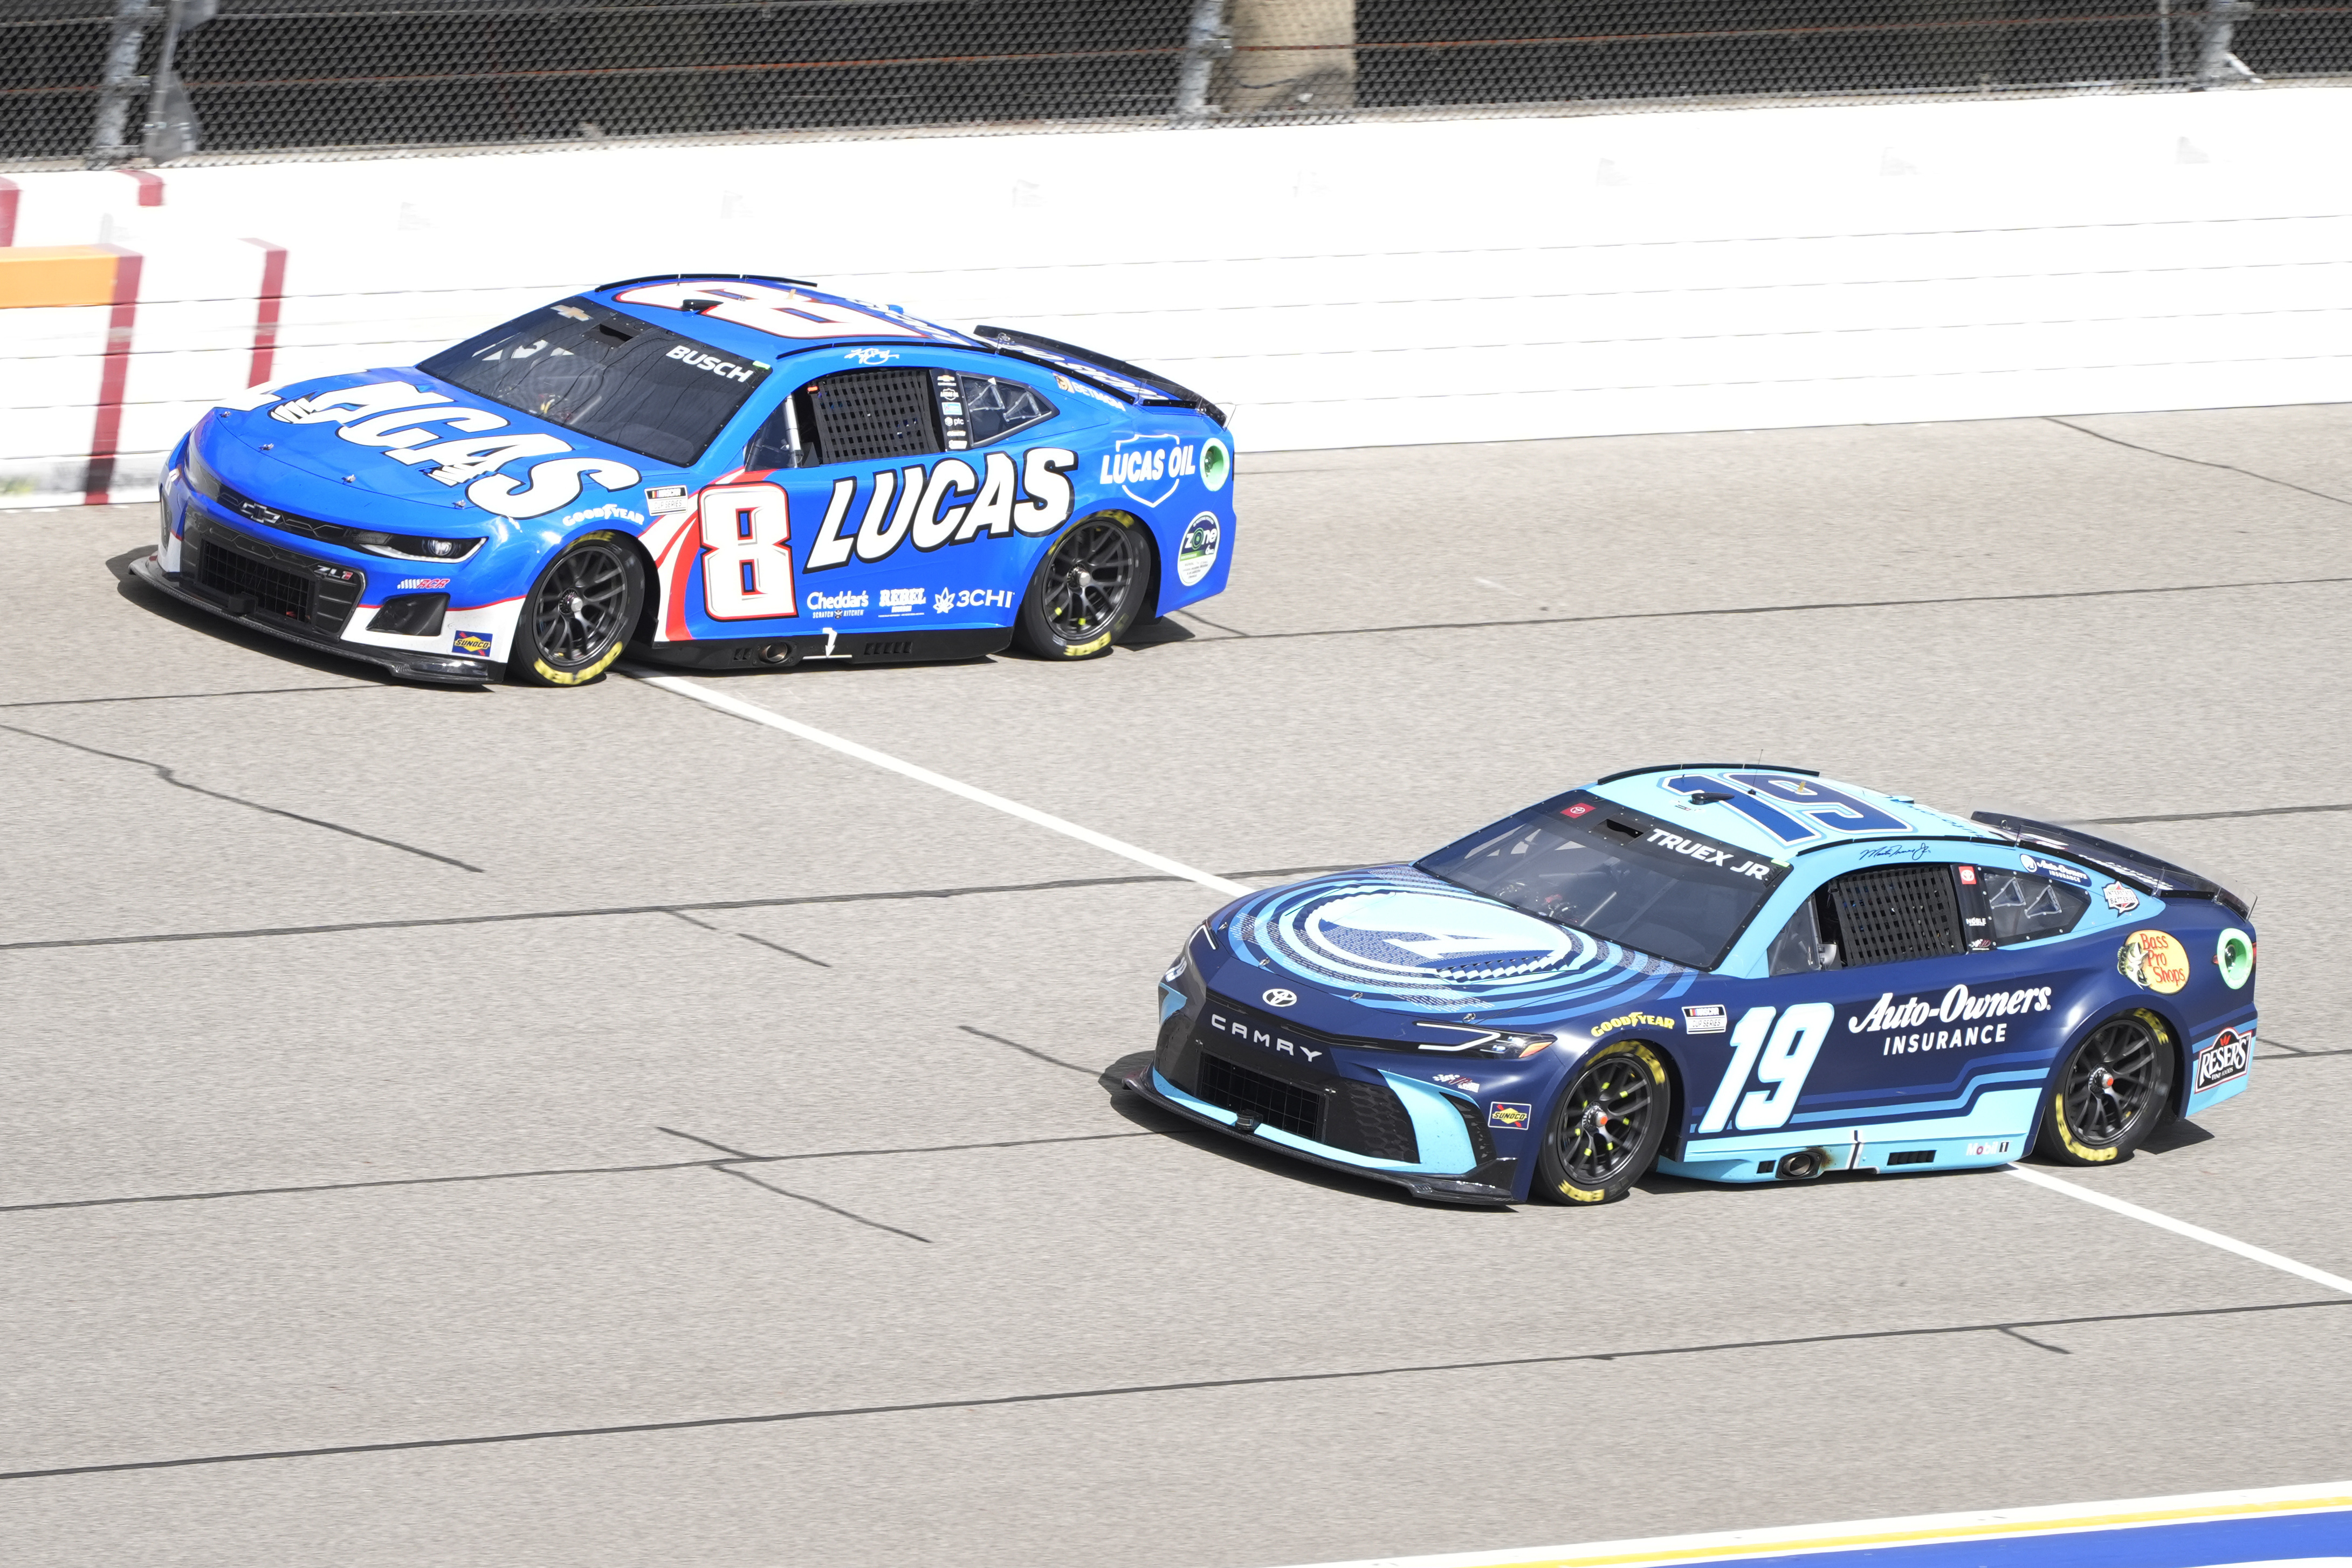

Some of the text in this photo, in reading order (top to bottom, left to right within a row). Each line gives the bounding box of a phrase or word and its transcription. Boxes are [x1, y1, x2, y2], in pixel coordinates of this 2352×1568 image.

[665, 345, 754, 382] BUSCH
[1100, 445, 1195, 484] LUCAS OIL
[658, 488, 681, 497] NASCAR
[654, 499, 682, 509] CUP SERIES
[803, 448, 1078, 574] LUCAS
[562, 504, 645, 526] GOODYEAR
[699, 482, 799, 620] 8
[314, 565, 353, 580] ZL1
[416, 579, 450, 589] RCR
[807, 590, 869, 610] Cheddar's
[879, 588, 926, 607] REBEL
[957, 589, 1012, 608] 3CHI
[456, 639, 490, 649] SUNOCO
[1659, 772, 1916, 848] 19
[1647, 828, 1770, 880] TRUEX JR
[2037, 860, 2088, 879] Auto-Owners
[2049, 870, 2081, 883] INSURANCE
[2110, 896, 2136, 904] BATTERIES
[2140, 933, 2168, 950] Bass
[2148, 950, 2167, 967] Pro
[2153, 966, 2185, 986] Shops
[1697, 1007, 1720, 1016] NASCAR
[1848, 984, 2052, 1033] Auto-Owners
[1591, 1012, 1675, 1037] GOODYEAR
[1693, 1019, 1721, 1028] CUP SERIES
[1212, 1014, 1323, 1062] CAMRY
[1883, 1023, 2007, 1056] INSURANCE
[1698, 1002, 1835, 1133] 19
[1494, 1112, 1526, 1120] SUNOCO
[1966, 1141, 1999, 1156] Mobil
